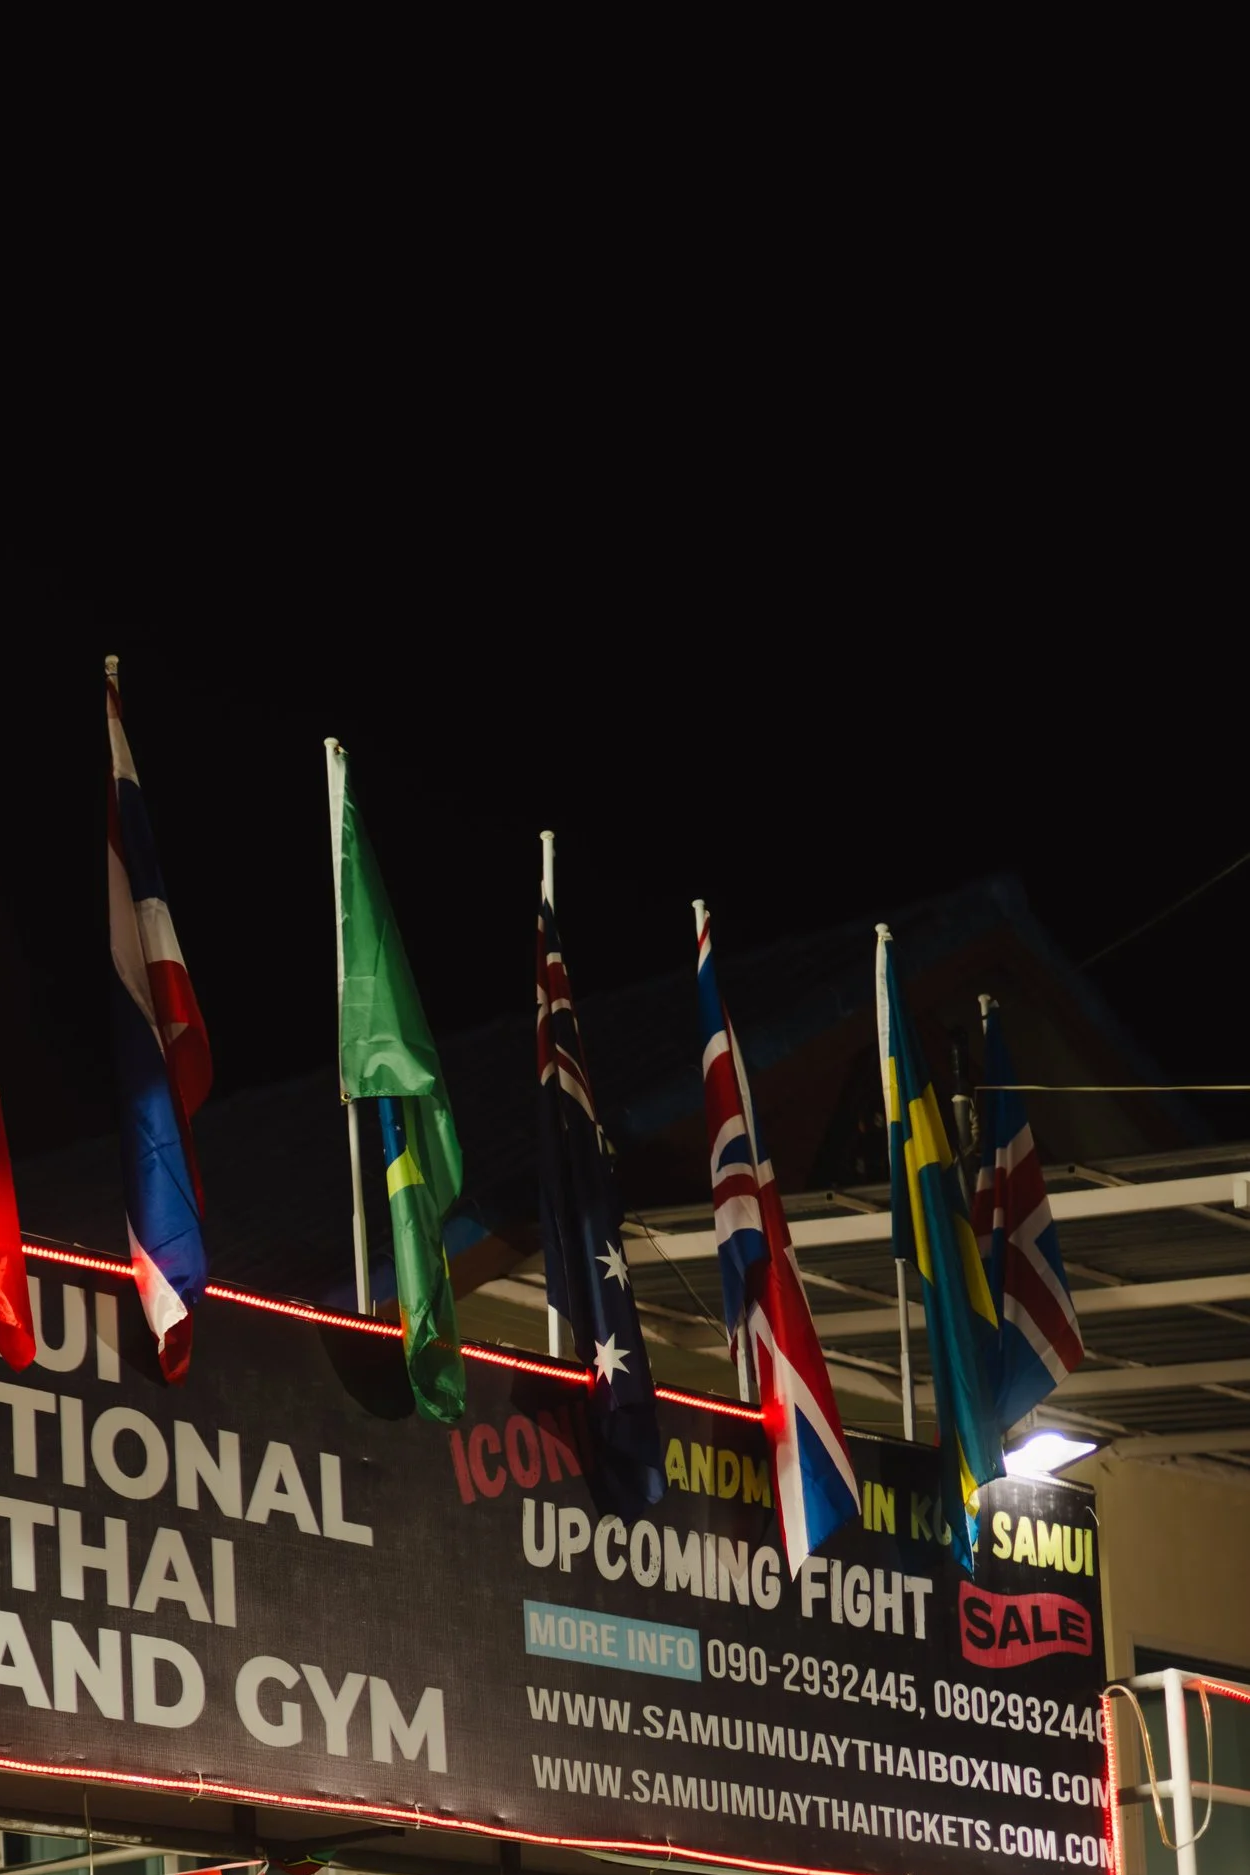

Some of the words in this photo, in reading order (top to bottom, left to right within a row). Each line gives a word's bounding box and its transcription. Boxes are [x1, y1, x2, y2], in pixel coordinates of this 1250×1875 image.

[522, 1497, 781, 1611] UPCOMING
[800, 1557, 934, 1640] FIGHT
[863, 1480, 897, 1536] IN
[992, 1510, 1095, 1577] SAMUI
[529, 1610, 618, 1659] MORE
[628, 1626, 697, 1671] INFO
[707, 1638, 927, 1720] 090-2932445,
[962, 1599, 1089, 1650] SALE
[235, 1655, 448, 1774] GYM
[527, 1685, 1112, 1809] WWW.SAMUIMUAYTHAIBOXING.COM
